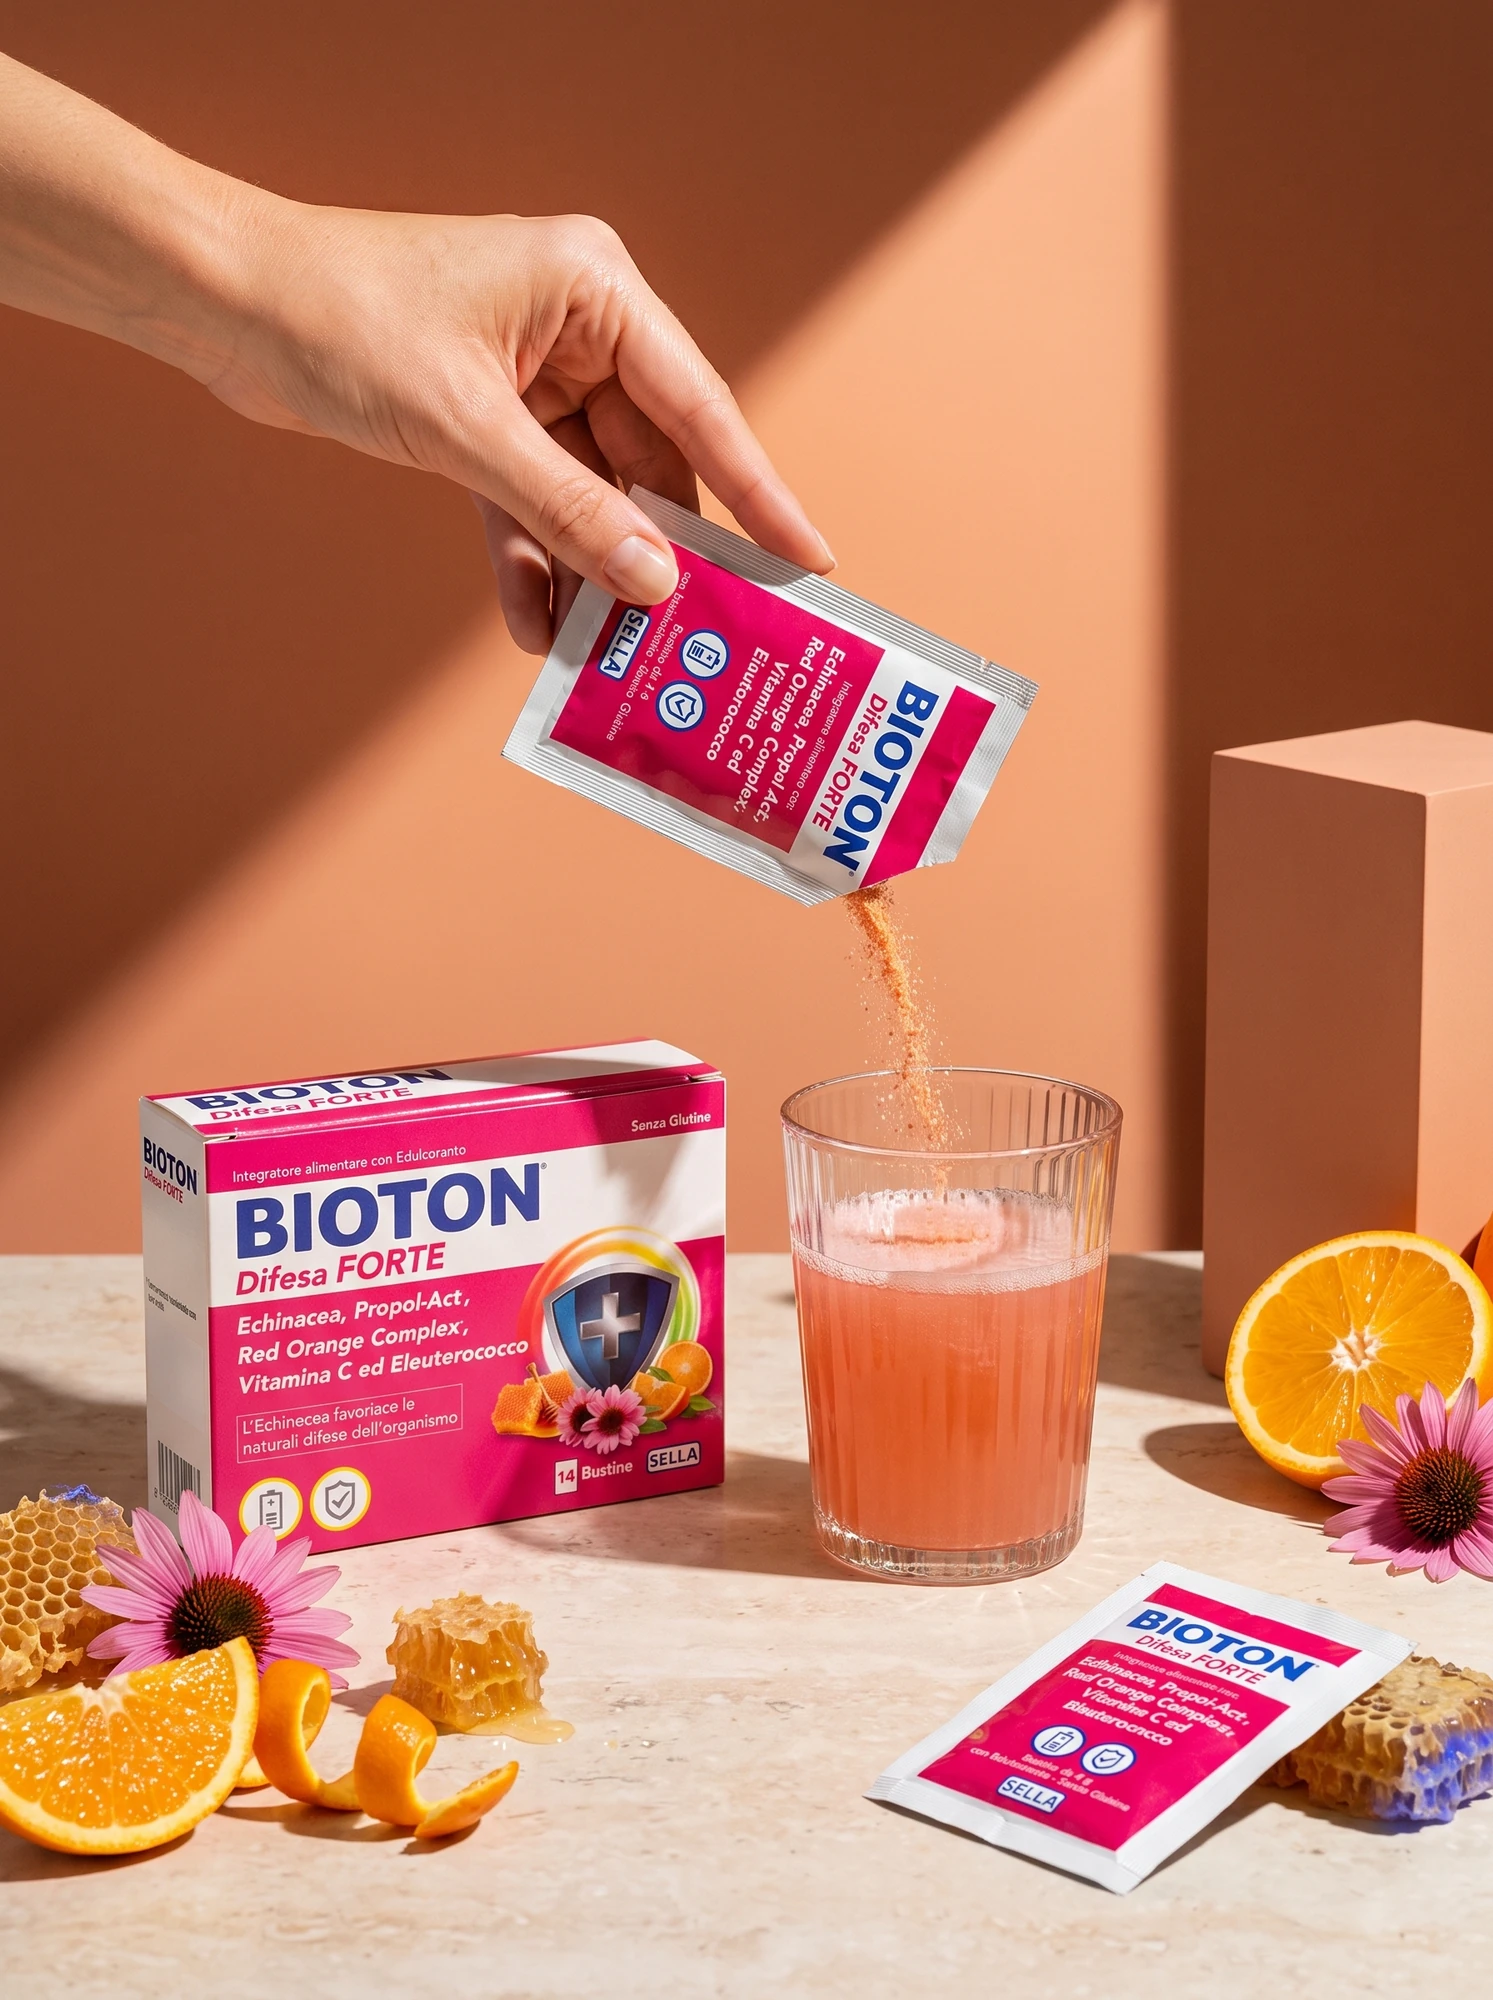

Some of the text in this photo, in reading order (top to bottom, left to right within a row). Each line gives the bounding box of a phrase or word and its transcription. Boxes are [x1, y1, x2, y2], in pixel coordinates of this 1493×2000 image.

[604, 613, 643, 672] SELLA
[799, 636, 825, 672] Red
[746, 662, 789, 729] Vitamina
[771, 673, 807, 732] Orange
[795, 646, 846, 728] Echinacea,
[727, 750, 743, 774] ed
[813, 694, 887, 831] Difesa FORTE
[824, 682, 938, 870] BIOTON
[185, 1069, 452, 1110] BIOTON
[210, 1087, 414, 1121] Difesa FORTE
[631, 1112, 711, 1132] Senza Glutine
[144, 1136, 197, 1195] BIOTON
[232, 1146, 466, 1183] Integratore alimentare con Edulcoranto
[236, 1162, 541, 1259] BIOTON
[236, 1241, 446, 1296] Difesa FORTE
[237, 1289, 470, 1335] Echinacea, Propol-Act,
[238, 1342, 280, 1365] Red
[286, 1334, 364, 1359] Orange
[239, 1340, 528, 1394] Vitamina C ed Eleuterococco
[333, 1402, 398, 1423] favoriace
[402, 1397, 415, 1411] le
[243, 1413, 458, 1455] naturali difese dell'organismo
[558, 1461, 633, 1484] 14 Bustine
[649, 1447, 698, 1468] SELLA
[1126, 1609, 1316, 1682] BIOTON
[1135, 1635, 1192, 1660] Difesa
[1191, 1654, 1267, 1685] FORTE
[1149, 1712, 1168, 1724] C
[1002, 1780, 1059, 1808] SELLA
